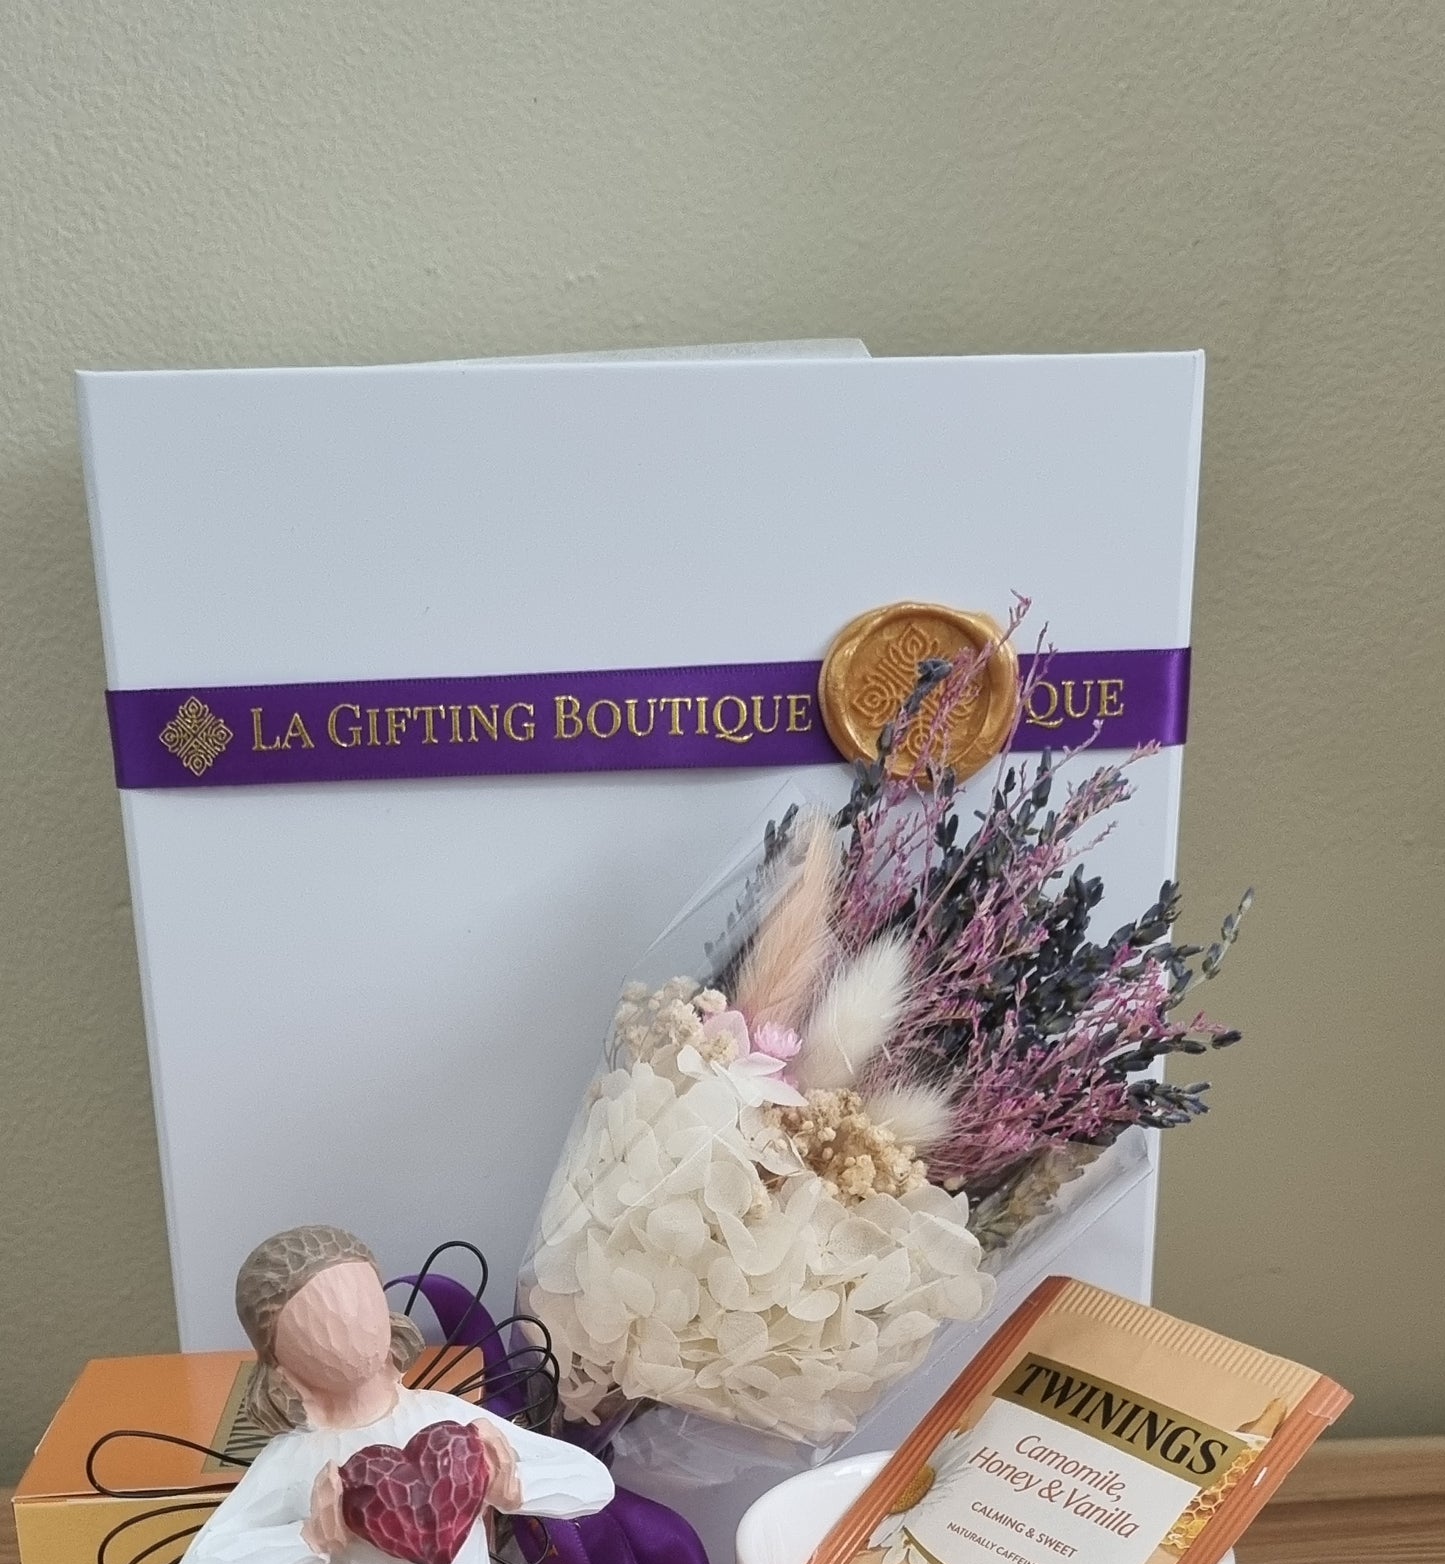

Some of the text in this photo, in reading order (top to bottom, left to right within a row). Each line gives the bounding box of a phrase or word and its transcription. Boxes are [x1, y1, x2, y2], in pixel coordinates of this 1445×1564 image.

[250, 694, 812, 750] LA GIFTING BOUTIQUE
[1013, 1363, 1229, 1475] TWININGS
[968, 1446, 1140, 1539] Honey & Vanilla
[1015, 1435, 1126, 1502] Camomile,
[946, 1521, 997, 1551] NATURALLY
[971, 1501, 1079, 1558] CALMING & SWEET
